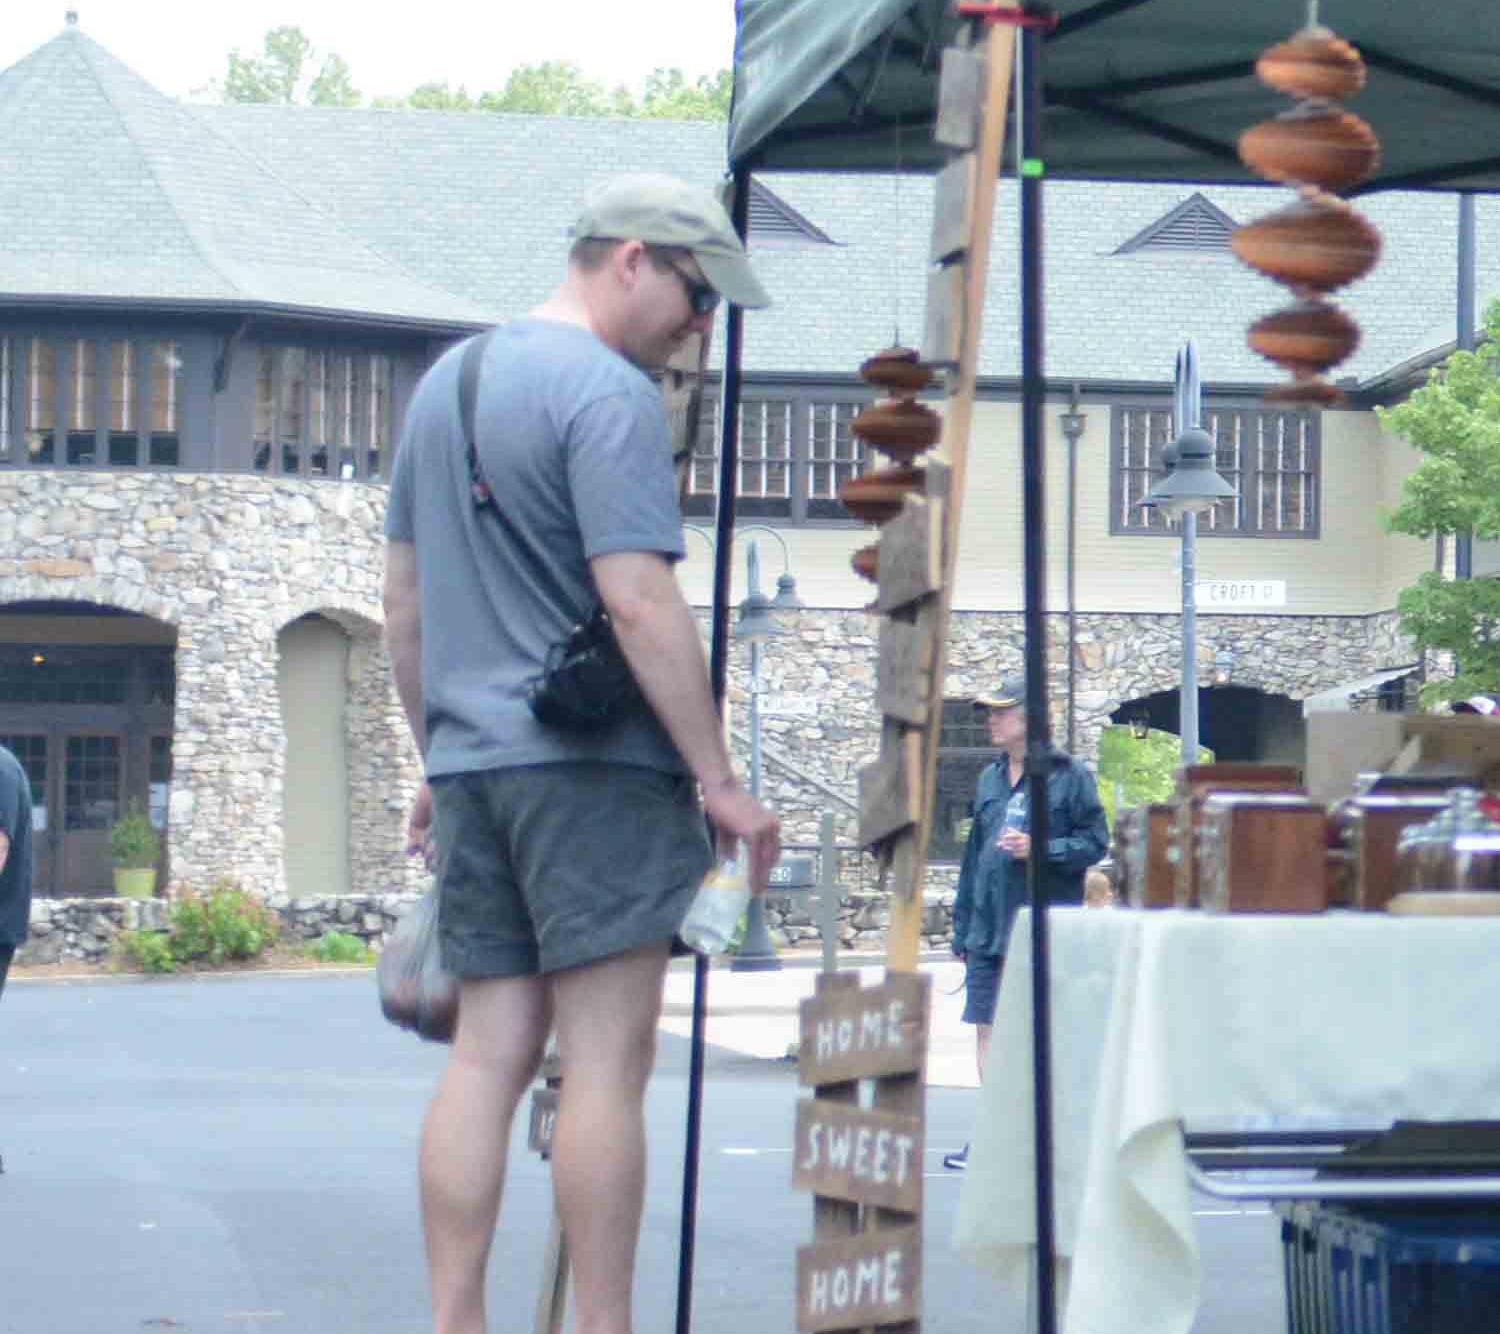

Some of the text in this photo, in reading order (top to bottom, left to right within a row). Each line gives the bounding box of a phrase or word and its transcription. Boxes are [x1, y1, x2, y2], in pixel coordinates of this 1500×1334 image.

[815, 999, 904, 1061] HOME
[803, 1122, 912, 1188] SWEET
[809, 1249, 904, 1314] HOME
